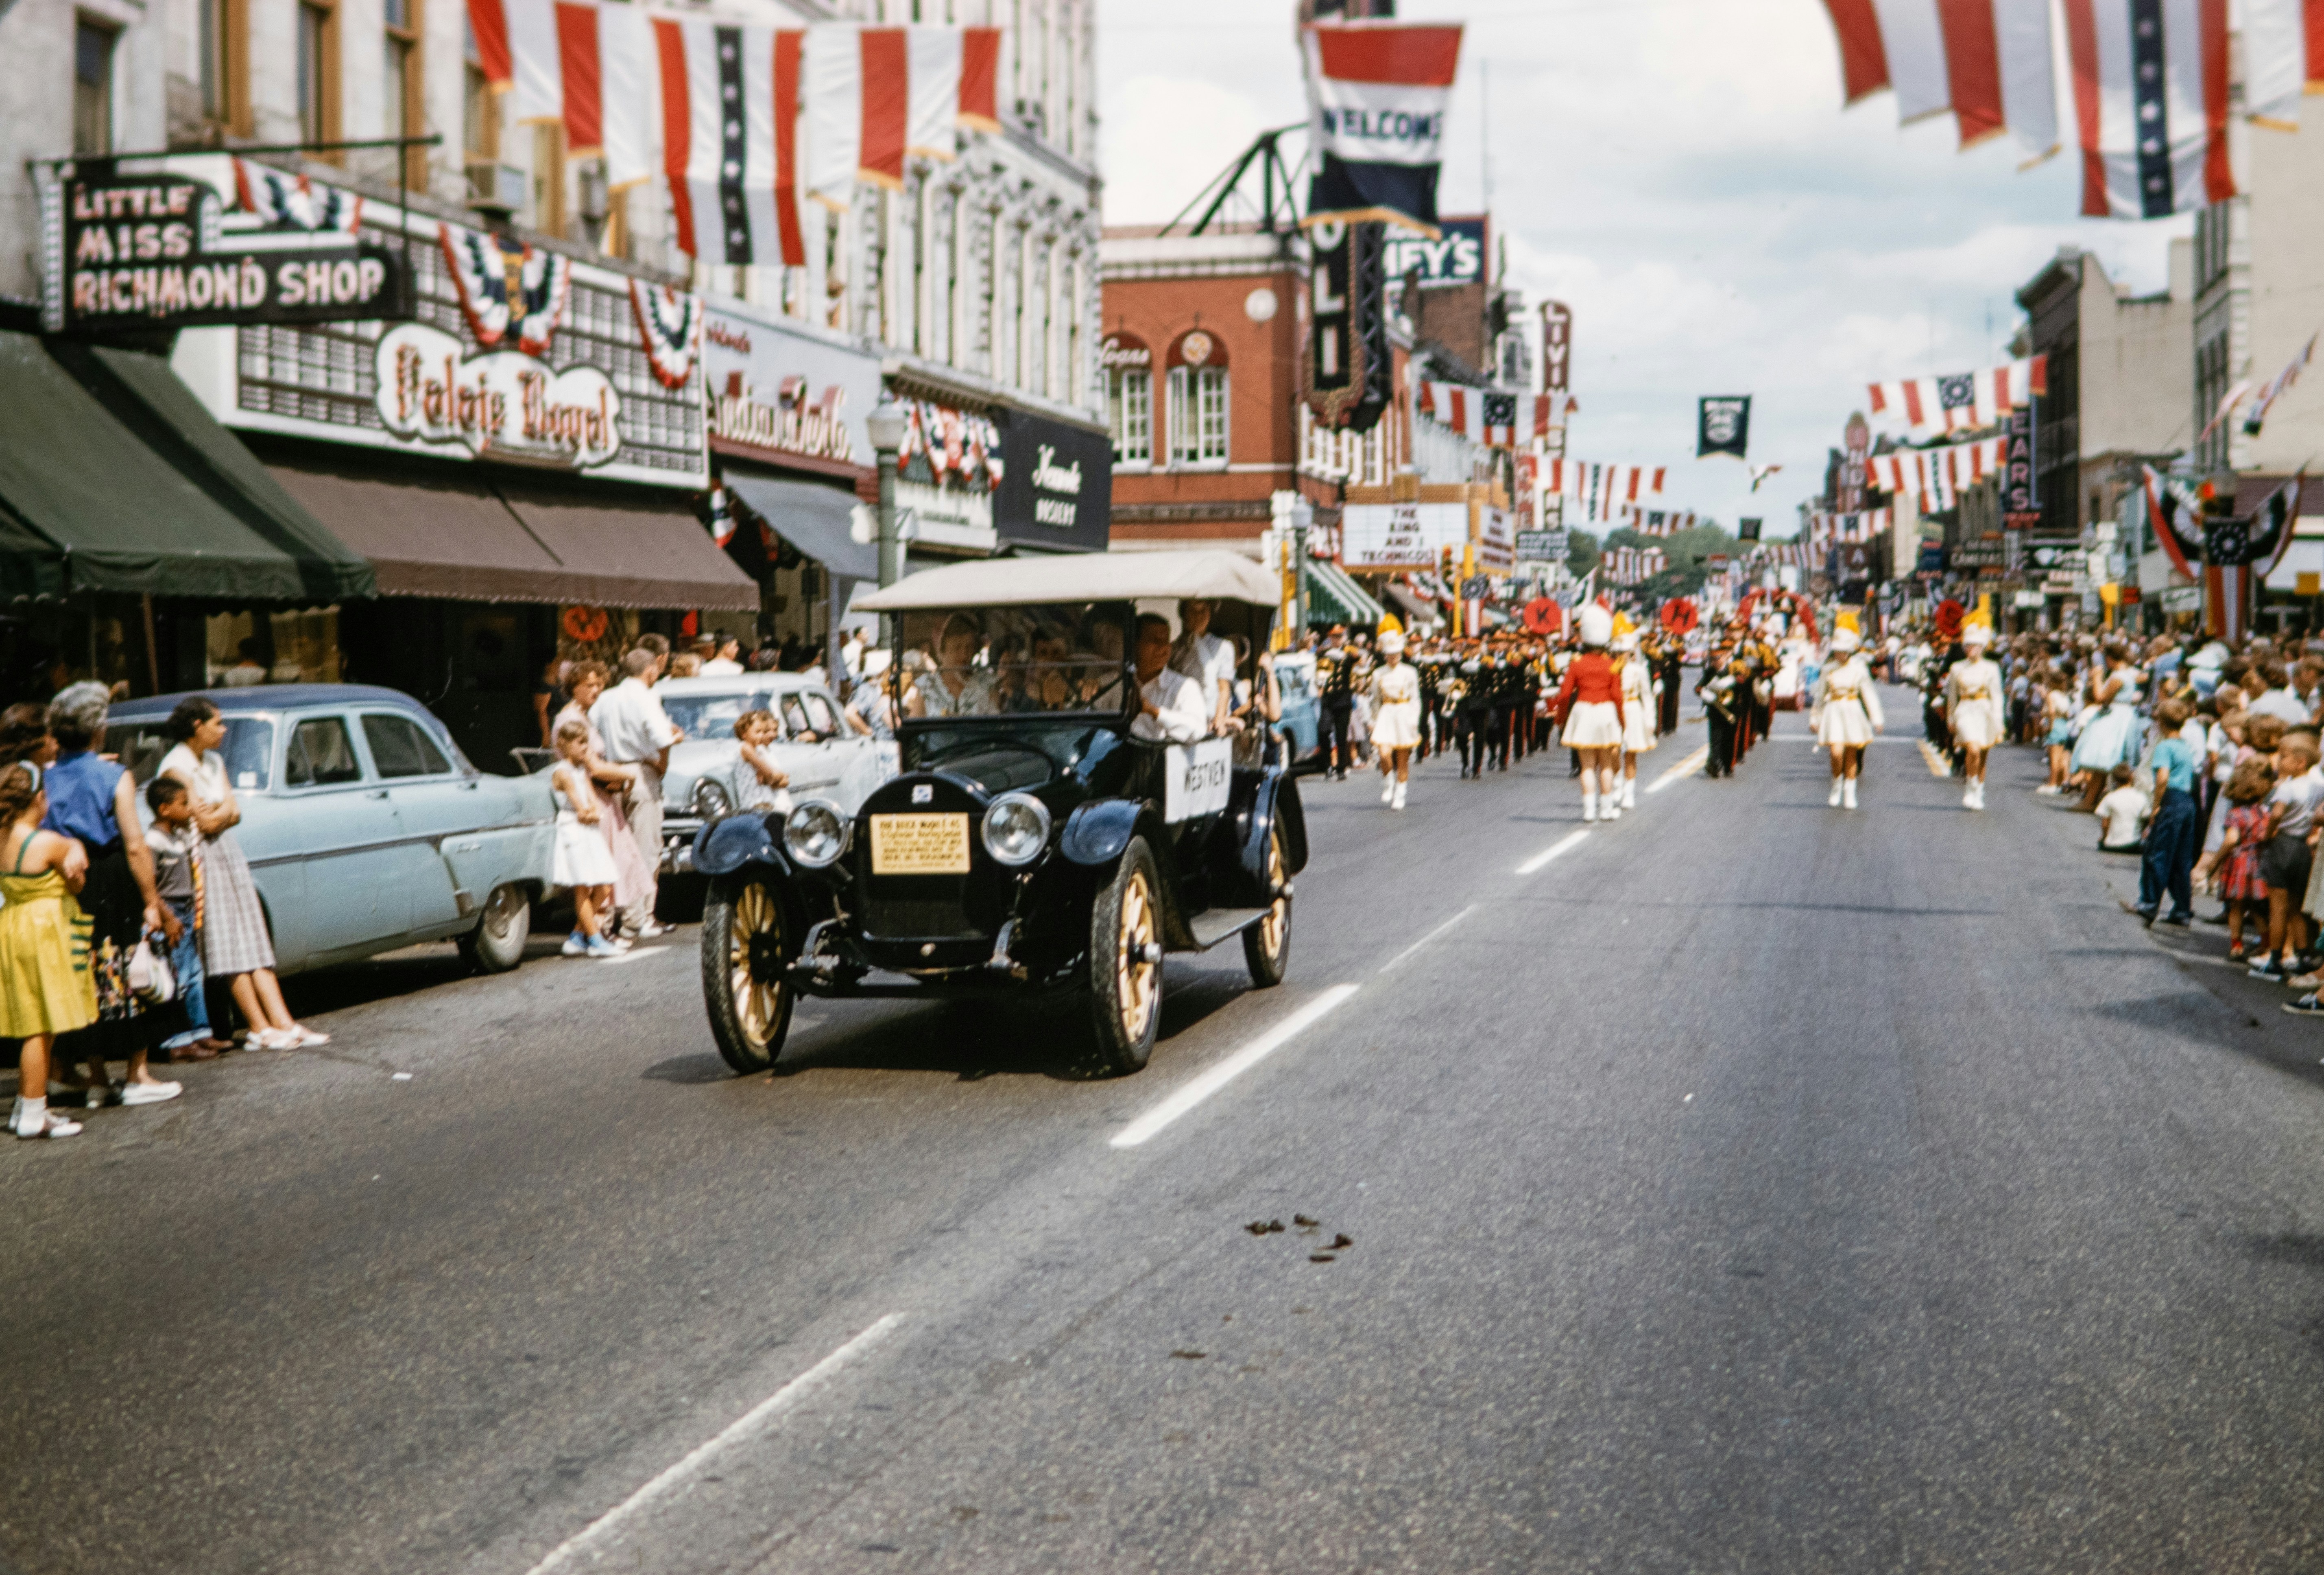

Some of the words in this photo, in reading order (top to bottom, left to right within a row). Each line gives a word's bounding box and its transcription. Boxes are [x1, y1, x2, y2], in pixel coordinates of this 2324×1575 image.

[74, 184, 194, 220] LITTLE
[76, 224, 192, 262] MISS
[1383, 230, 1478, 277] IFY'S
[74, 260, 267, 313] RICHMOND
[277, 256, 385, 306] SHOP
[2011, 410, 2029, 510] EARS
[1394, 508, 1416, 519] THE
